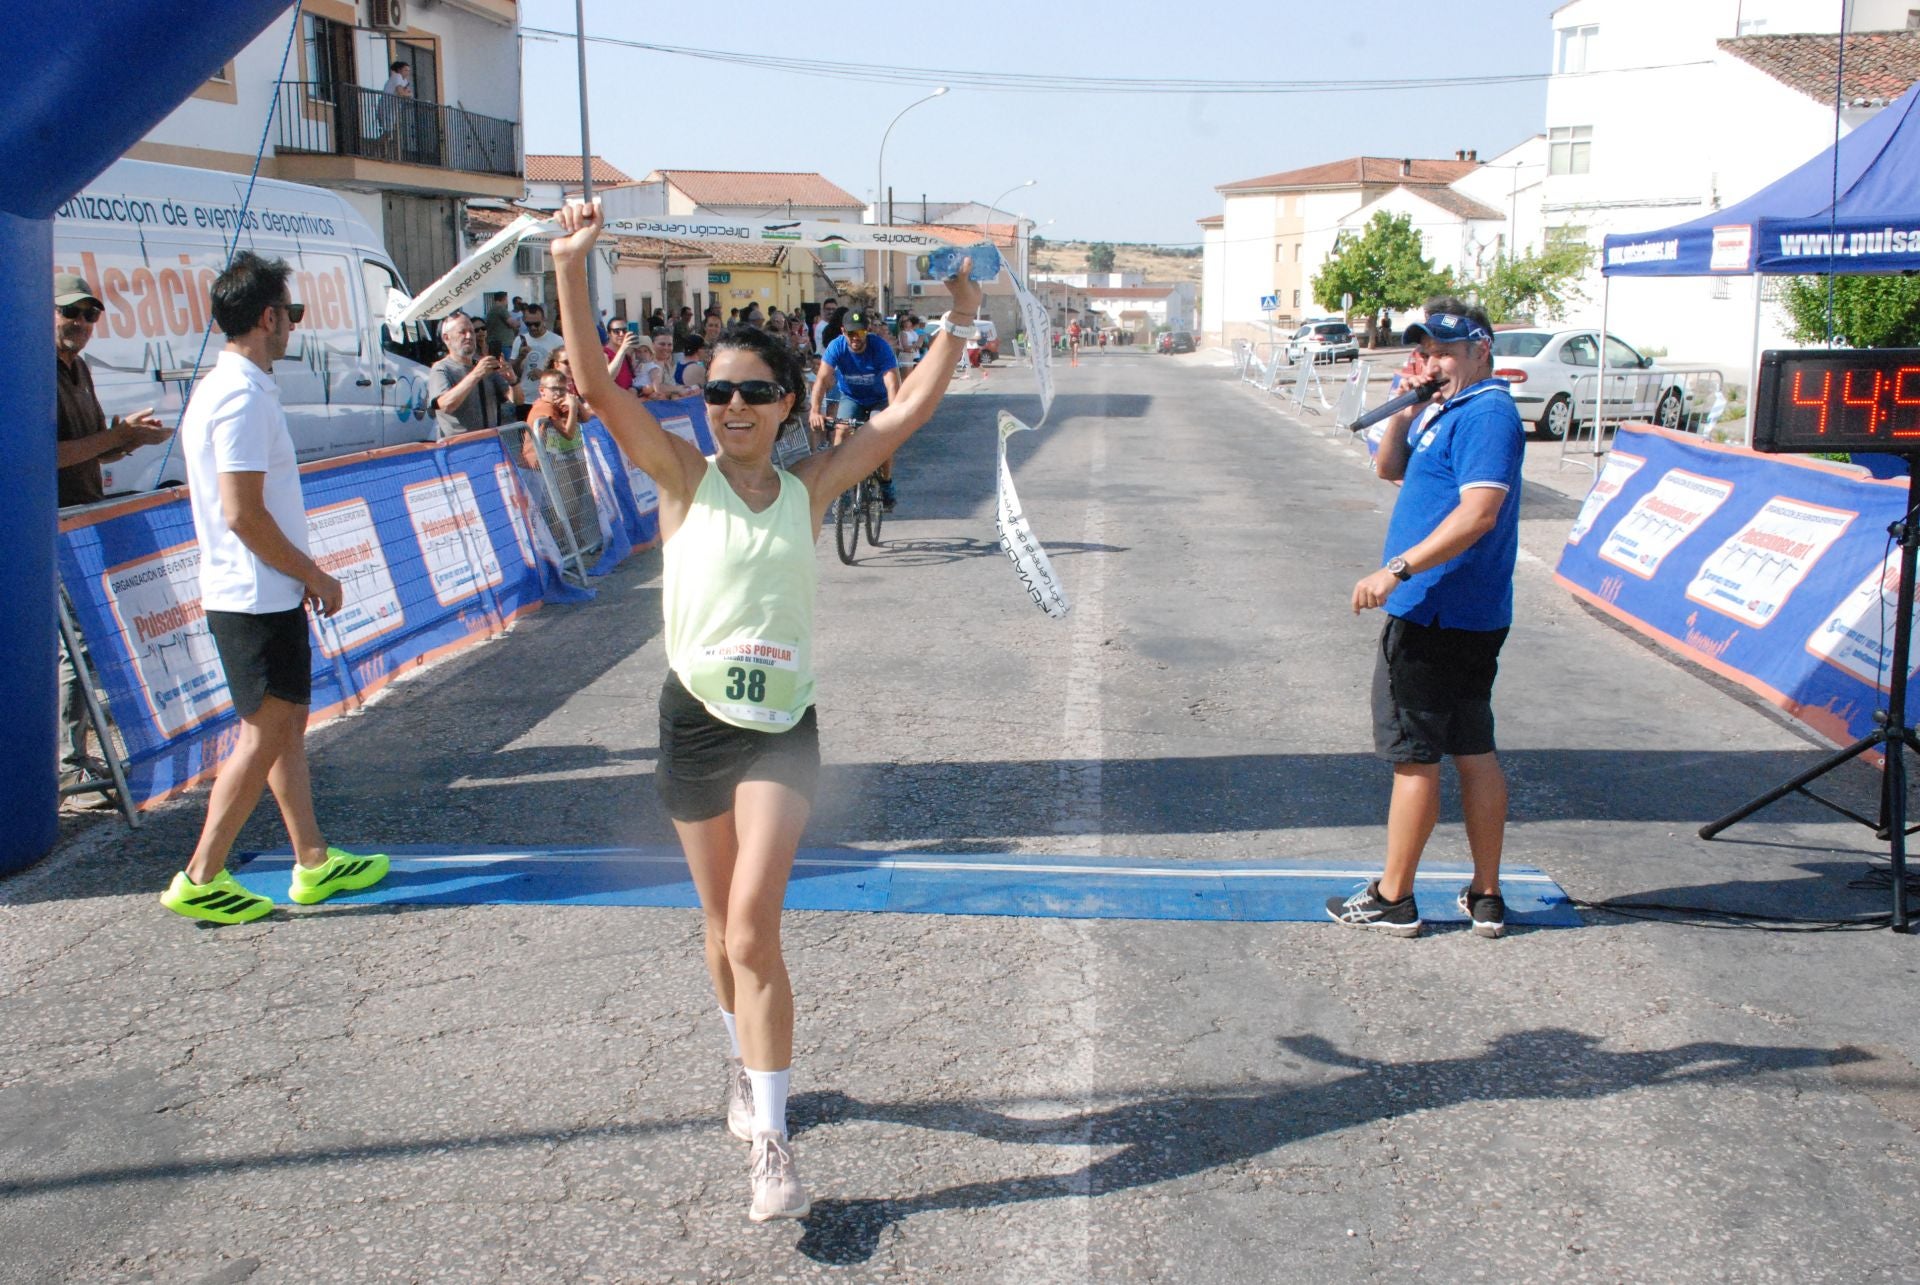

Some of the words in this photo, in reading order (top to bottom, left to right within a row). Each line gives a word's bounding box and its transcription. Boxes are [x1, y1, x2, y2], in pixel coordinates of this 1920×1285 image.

[163, 198, 188, 226] de
[194, 204, 258, 230] eventos
[262, 208, 335, 237] deportivos
[636, 222, 688, 236] General
[689, 225, 750, 239] Dirección
[872, 233, 928, 246] Deportes
[449, 270, 481, 299] General
[479, 260, 492, 274] de
[1015, 529, 1027, 543] de
[1023, 545, 1052, 585] General
[753, 645, 792, 662] POPULAR
[726, 666, 767, 703] 38
